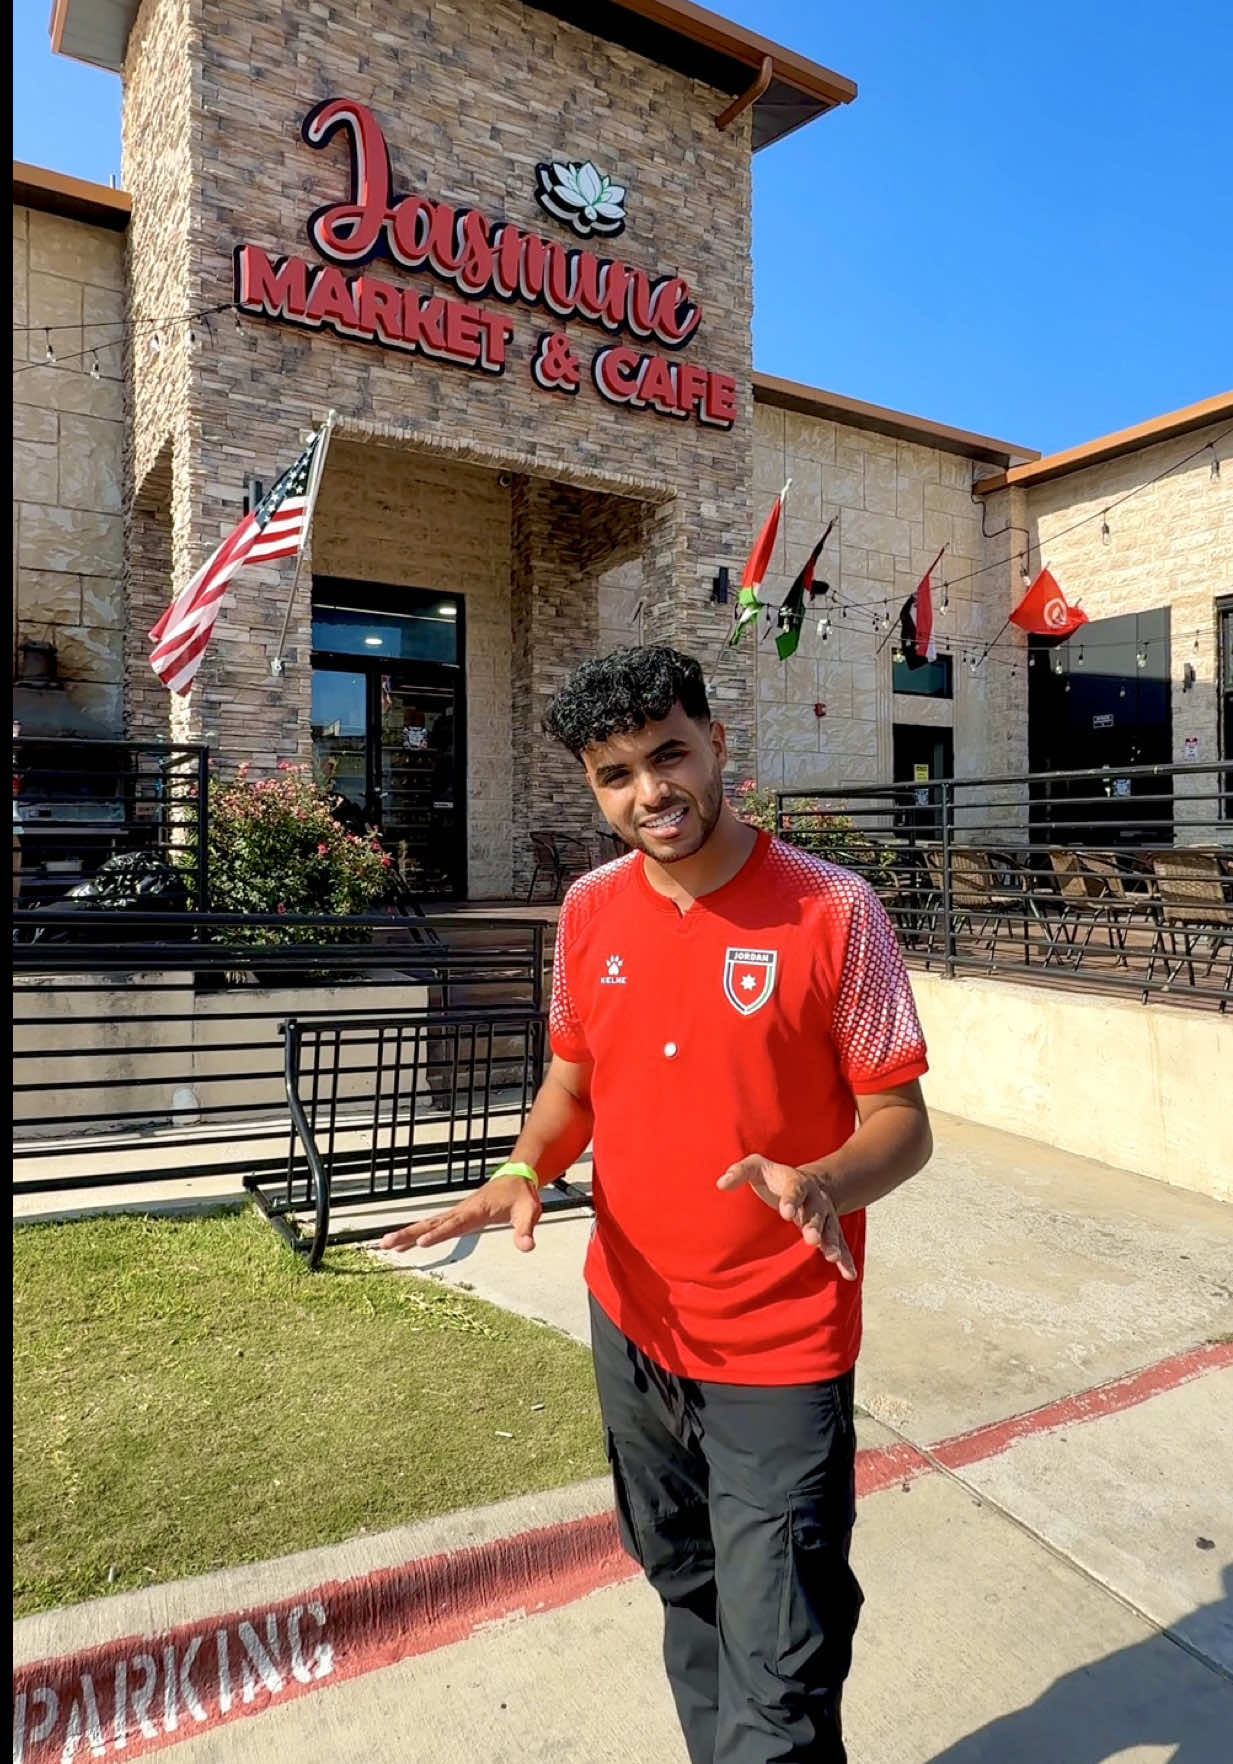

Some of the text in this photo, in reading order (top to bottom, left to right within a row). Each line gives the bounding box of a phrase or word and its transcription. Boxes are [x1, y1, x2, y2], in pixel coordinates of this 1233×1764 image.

[302, 98, 702, 349] Jasmine
[235, 245, 739, 430] MARKET & CAFE
[734, 951, 769, 962] JORDAN
[13, 1603, 335, 1764] PARKING
